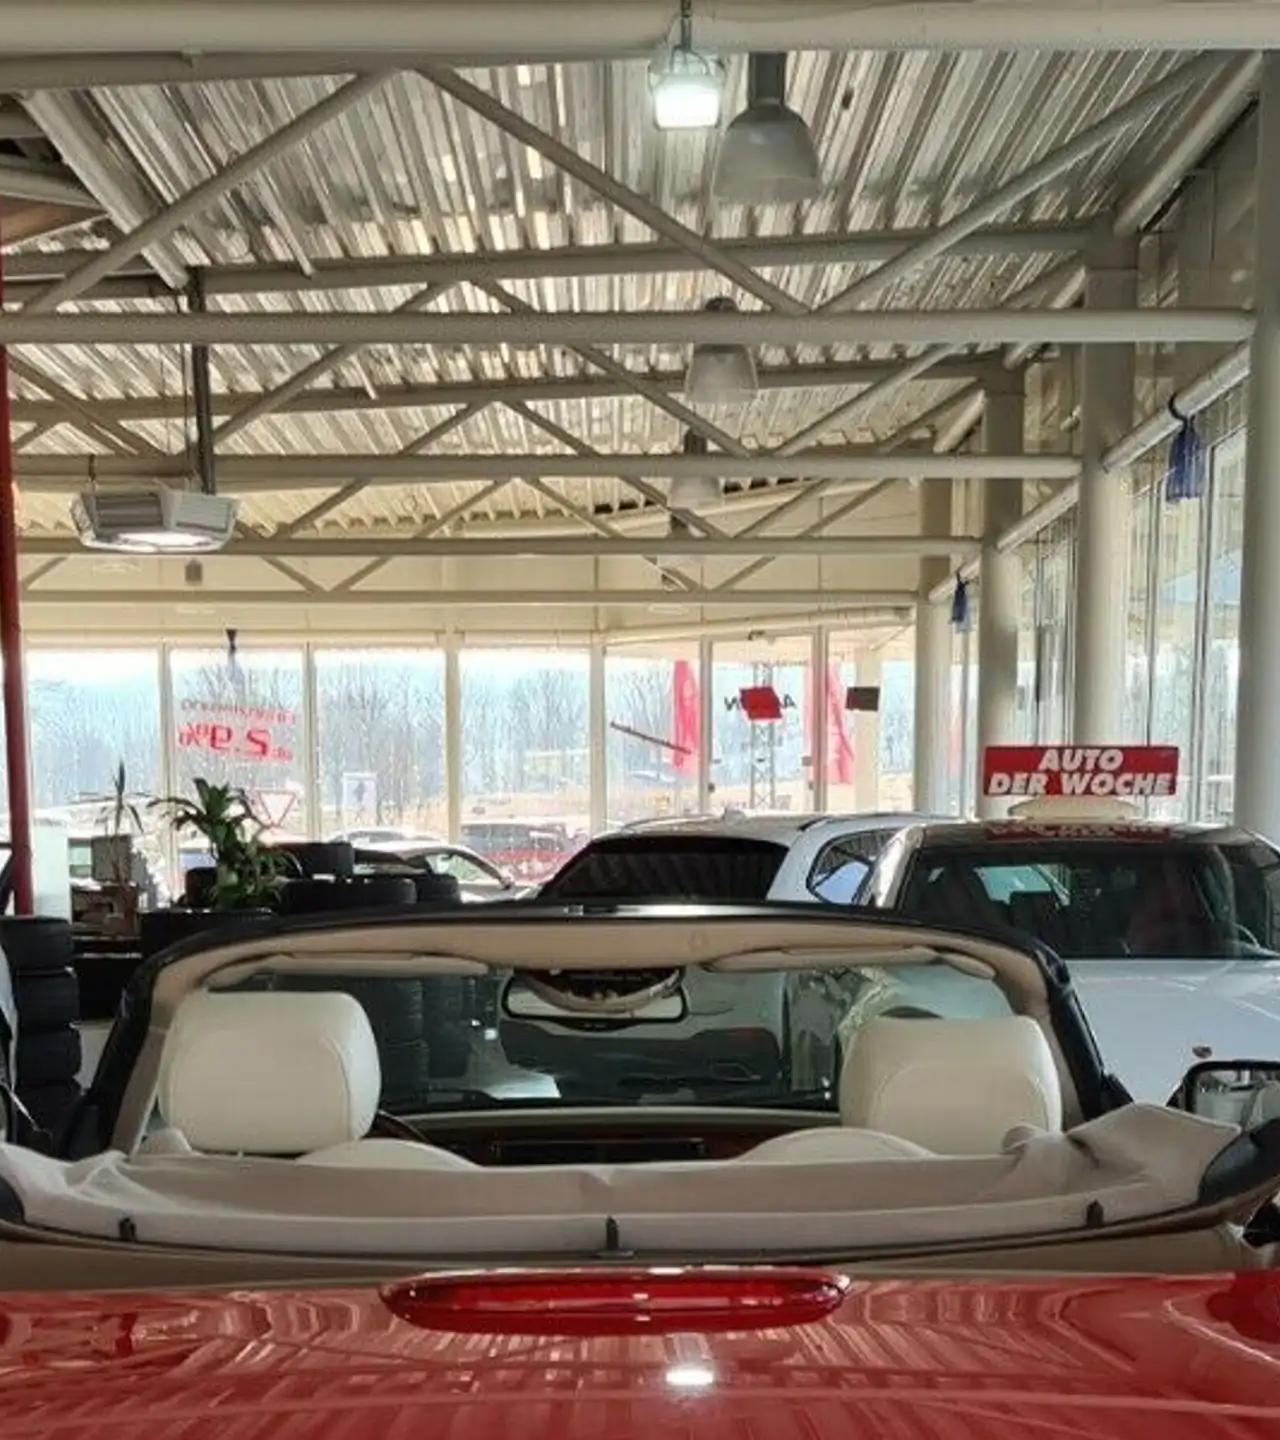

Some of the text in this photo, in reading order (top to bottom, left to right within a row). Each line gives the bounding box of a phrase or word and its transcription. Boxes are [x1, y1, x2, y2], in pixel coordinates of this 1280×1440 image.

[1038, 749, 1123, 771] AUTO
[988, 772, 1172, 796] DER WOCHE
